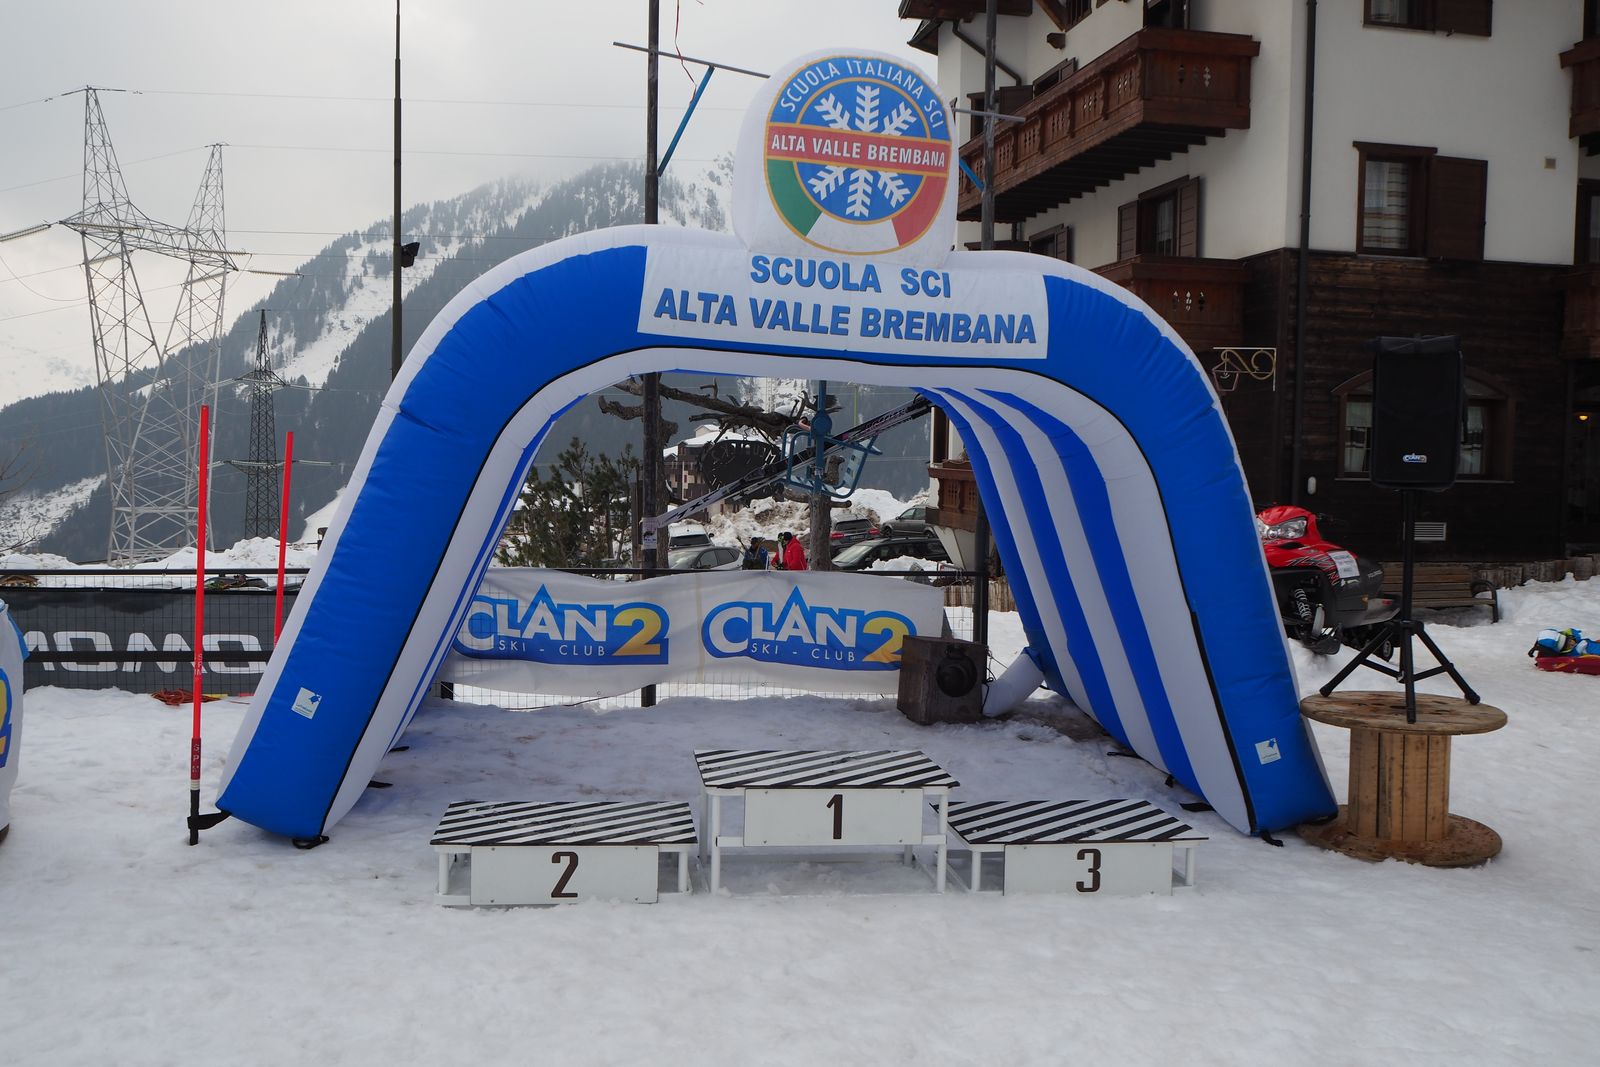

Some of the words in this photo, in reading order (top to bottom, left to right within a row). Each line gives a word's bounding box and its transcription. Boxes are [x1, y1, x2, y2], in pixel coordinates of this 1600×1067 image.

[781, 61, 841, 112] SCUOLA
[846, 60, 924, 99] ITALIANA
[923, 98, 945, 129] SCI
[771, 134, 806, 153] ALTA
[812, 137, 862, 159] VALLE
[867, 144, 945, 167] BREMBANA
[750, 255, 881, 293] SCUOLA
[900, 268, 951, 298] SCI
[653, 288, 737, 326] ALTA
[749, 298, 851, 336] VALLE
[860, 307, 1037, 344] BREMBANA
[498, 639, 526, 652] SKI
[559, 644, 605, 656] CLUB
[751, 642, 778, 655] SKI
[811, 648, 855, 662] CLUB
[825, 794, 844, 840] 1
[550, 852, 580, 898] 2
[1076, 848, 1101, 894] 3
